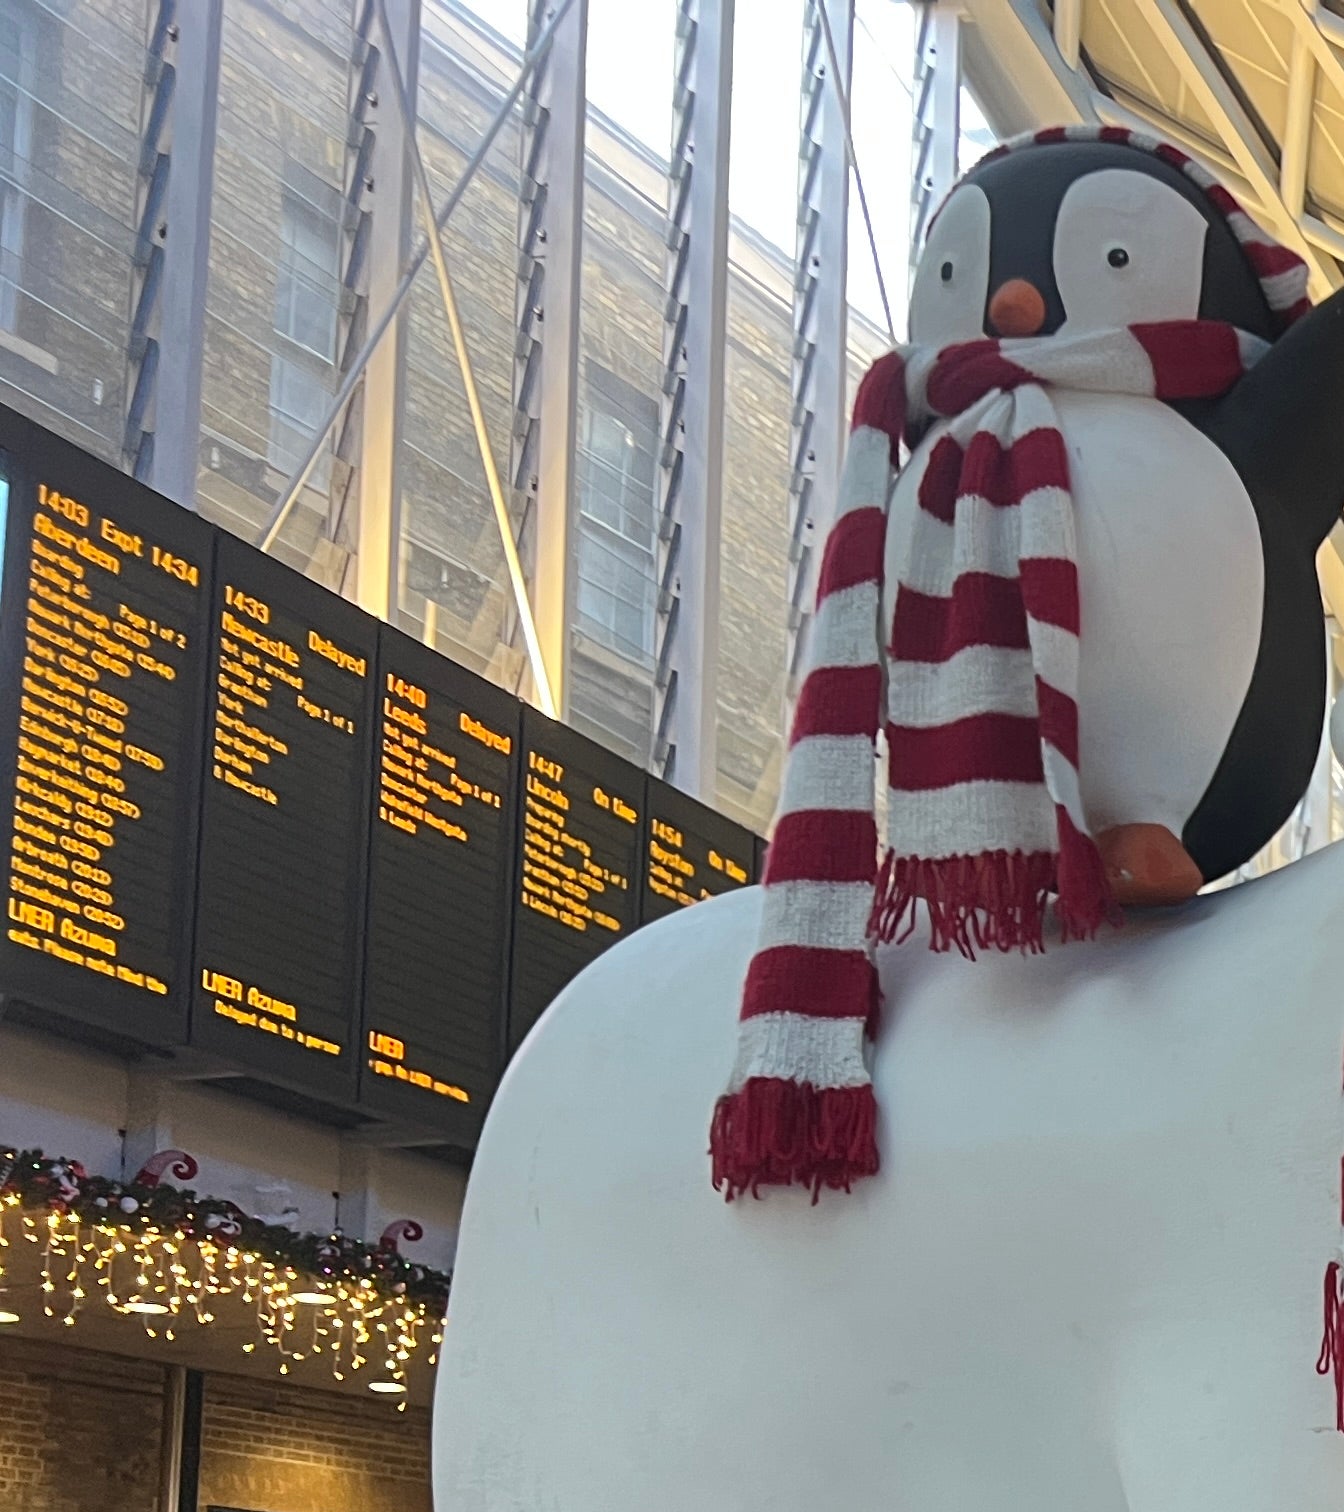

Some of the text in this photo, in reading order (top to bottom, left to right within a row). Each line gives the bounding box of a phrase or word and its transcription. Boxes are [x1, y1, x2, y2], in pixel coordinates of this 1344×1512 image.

[33, 512, 120, 575] Aberdeen
[149, 620, 157, 635] 1
[221, 611, 300, 668] Newcastle
[308, 630, 366, 677] Delayed
[384, 697, 427, 735] Leeds
[8, 897, 55, 934] LNER
[60, 917, 117, 957] Azuma
[202, 969, 243, 1002] LNER
